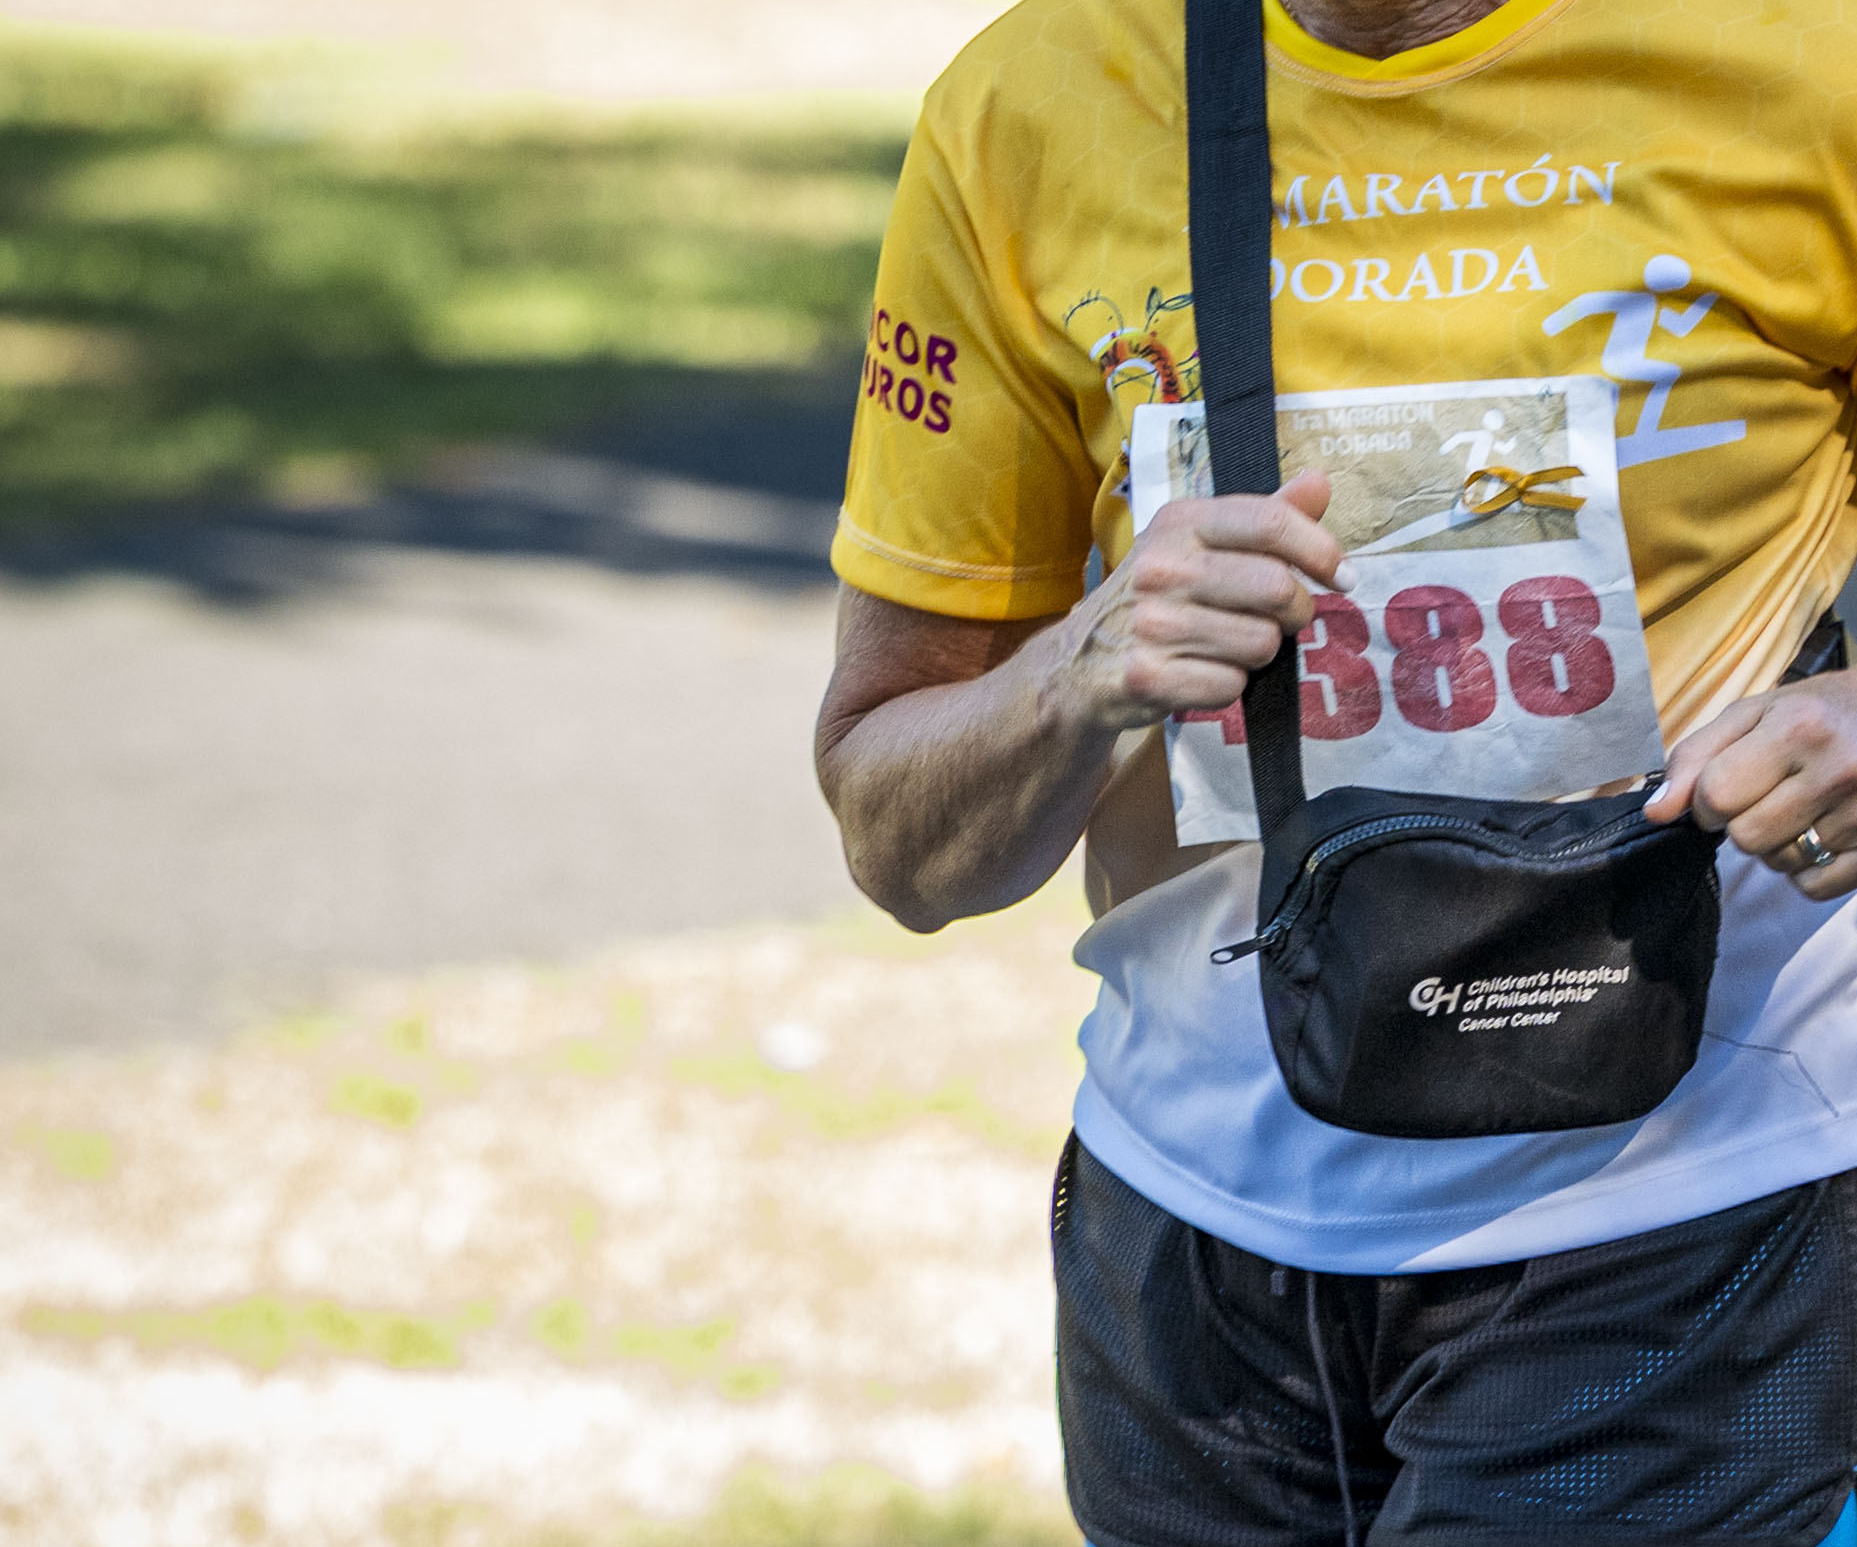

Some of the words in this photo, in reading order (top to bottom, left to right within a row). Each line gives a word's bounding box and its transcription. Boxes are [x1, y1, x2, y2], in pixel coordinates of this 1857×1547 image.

[1271, 152, 1623, 230] MARATÓN
[871, 306, 957, 385] COR
[1172, 574, 1616, 746] 388
[1462, 994, 1486, 1013] of
[1485, 984, 1599, 1011] Philadelphia
[1467, 970, 1550, 996] Children's
[1551, 964, 1631, 987] Hospital
[1510, 1010, 1562, 1028] Center
